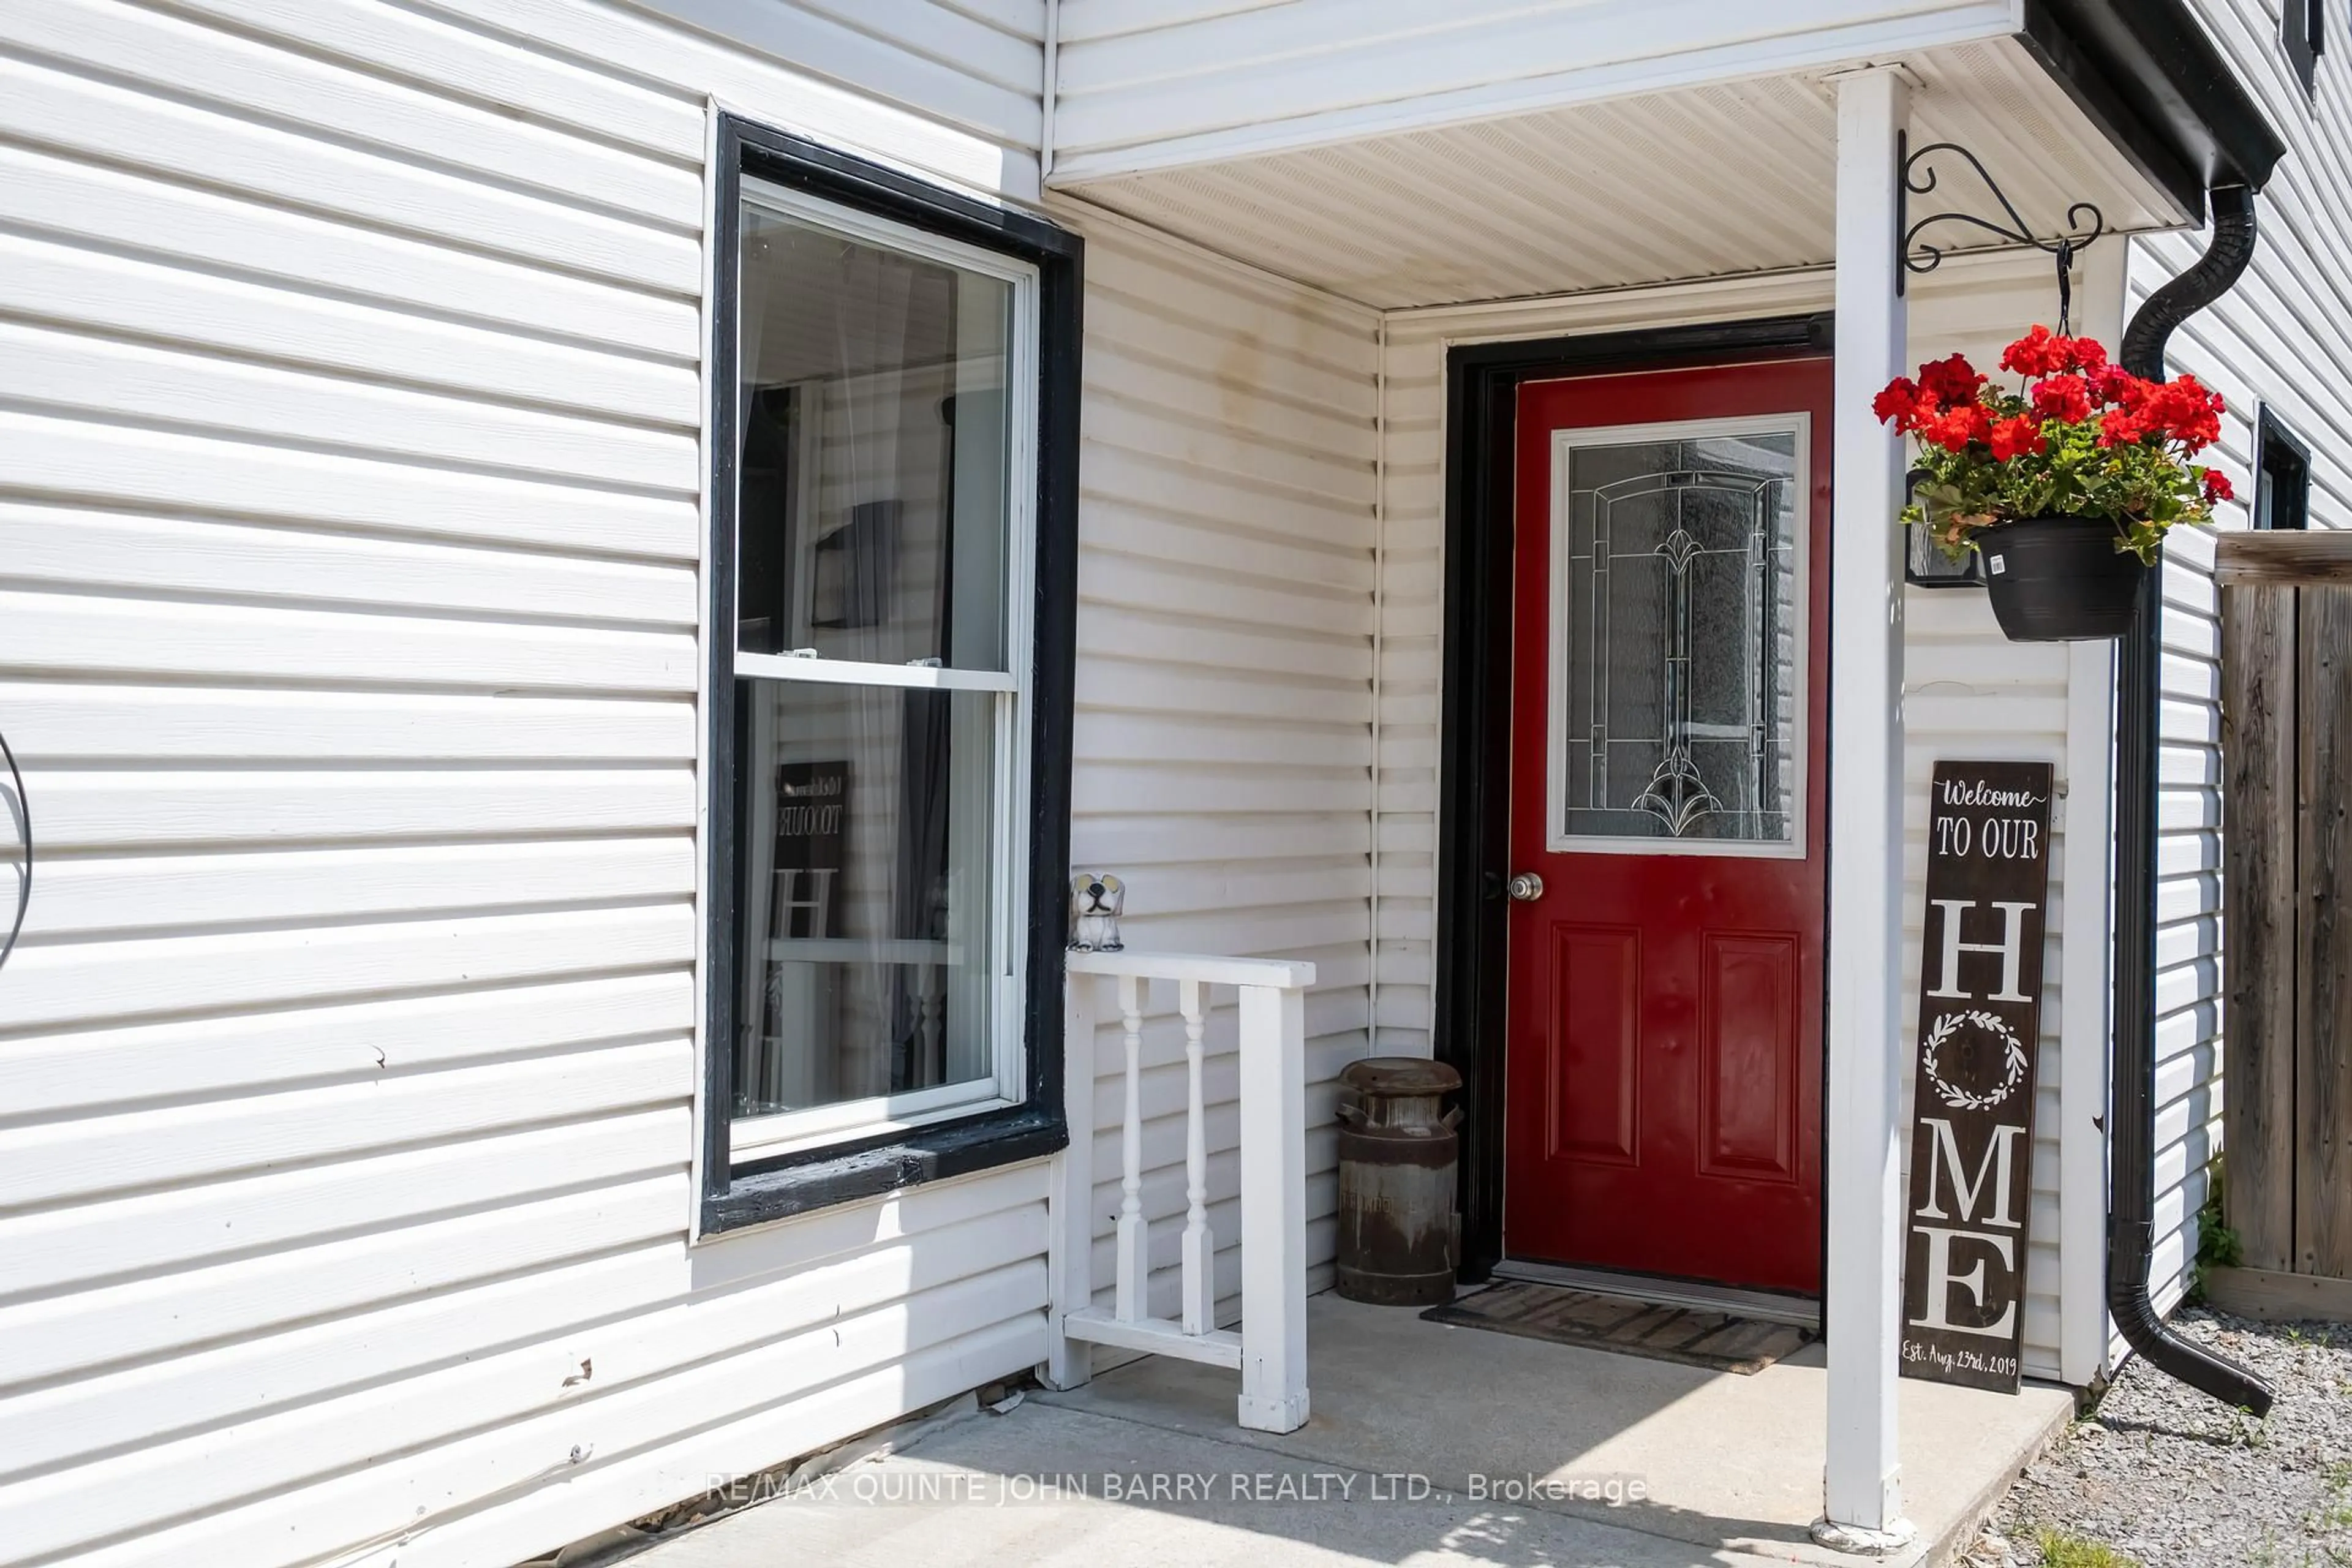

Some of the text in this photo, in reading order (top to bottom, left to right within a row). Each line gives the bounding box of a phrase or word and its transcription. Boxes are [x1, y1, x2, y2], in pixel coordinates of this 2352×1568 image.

[1934, 779, 2046, 807] Welcome
[1937, 816, 2038, 859] TO OUR
[1902, 1340, 1927, 1362] Est.
[1929, 1344, 1955, 1373] Aug.
[1989, 1355, 2017, 1376] 2019
